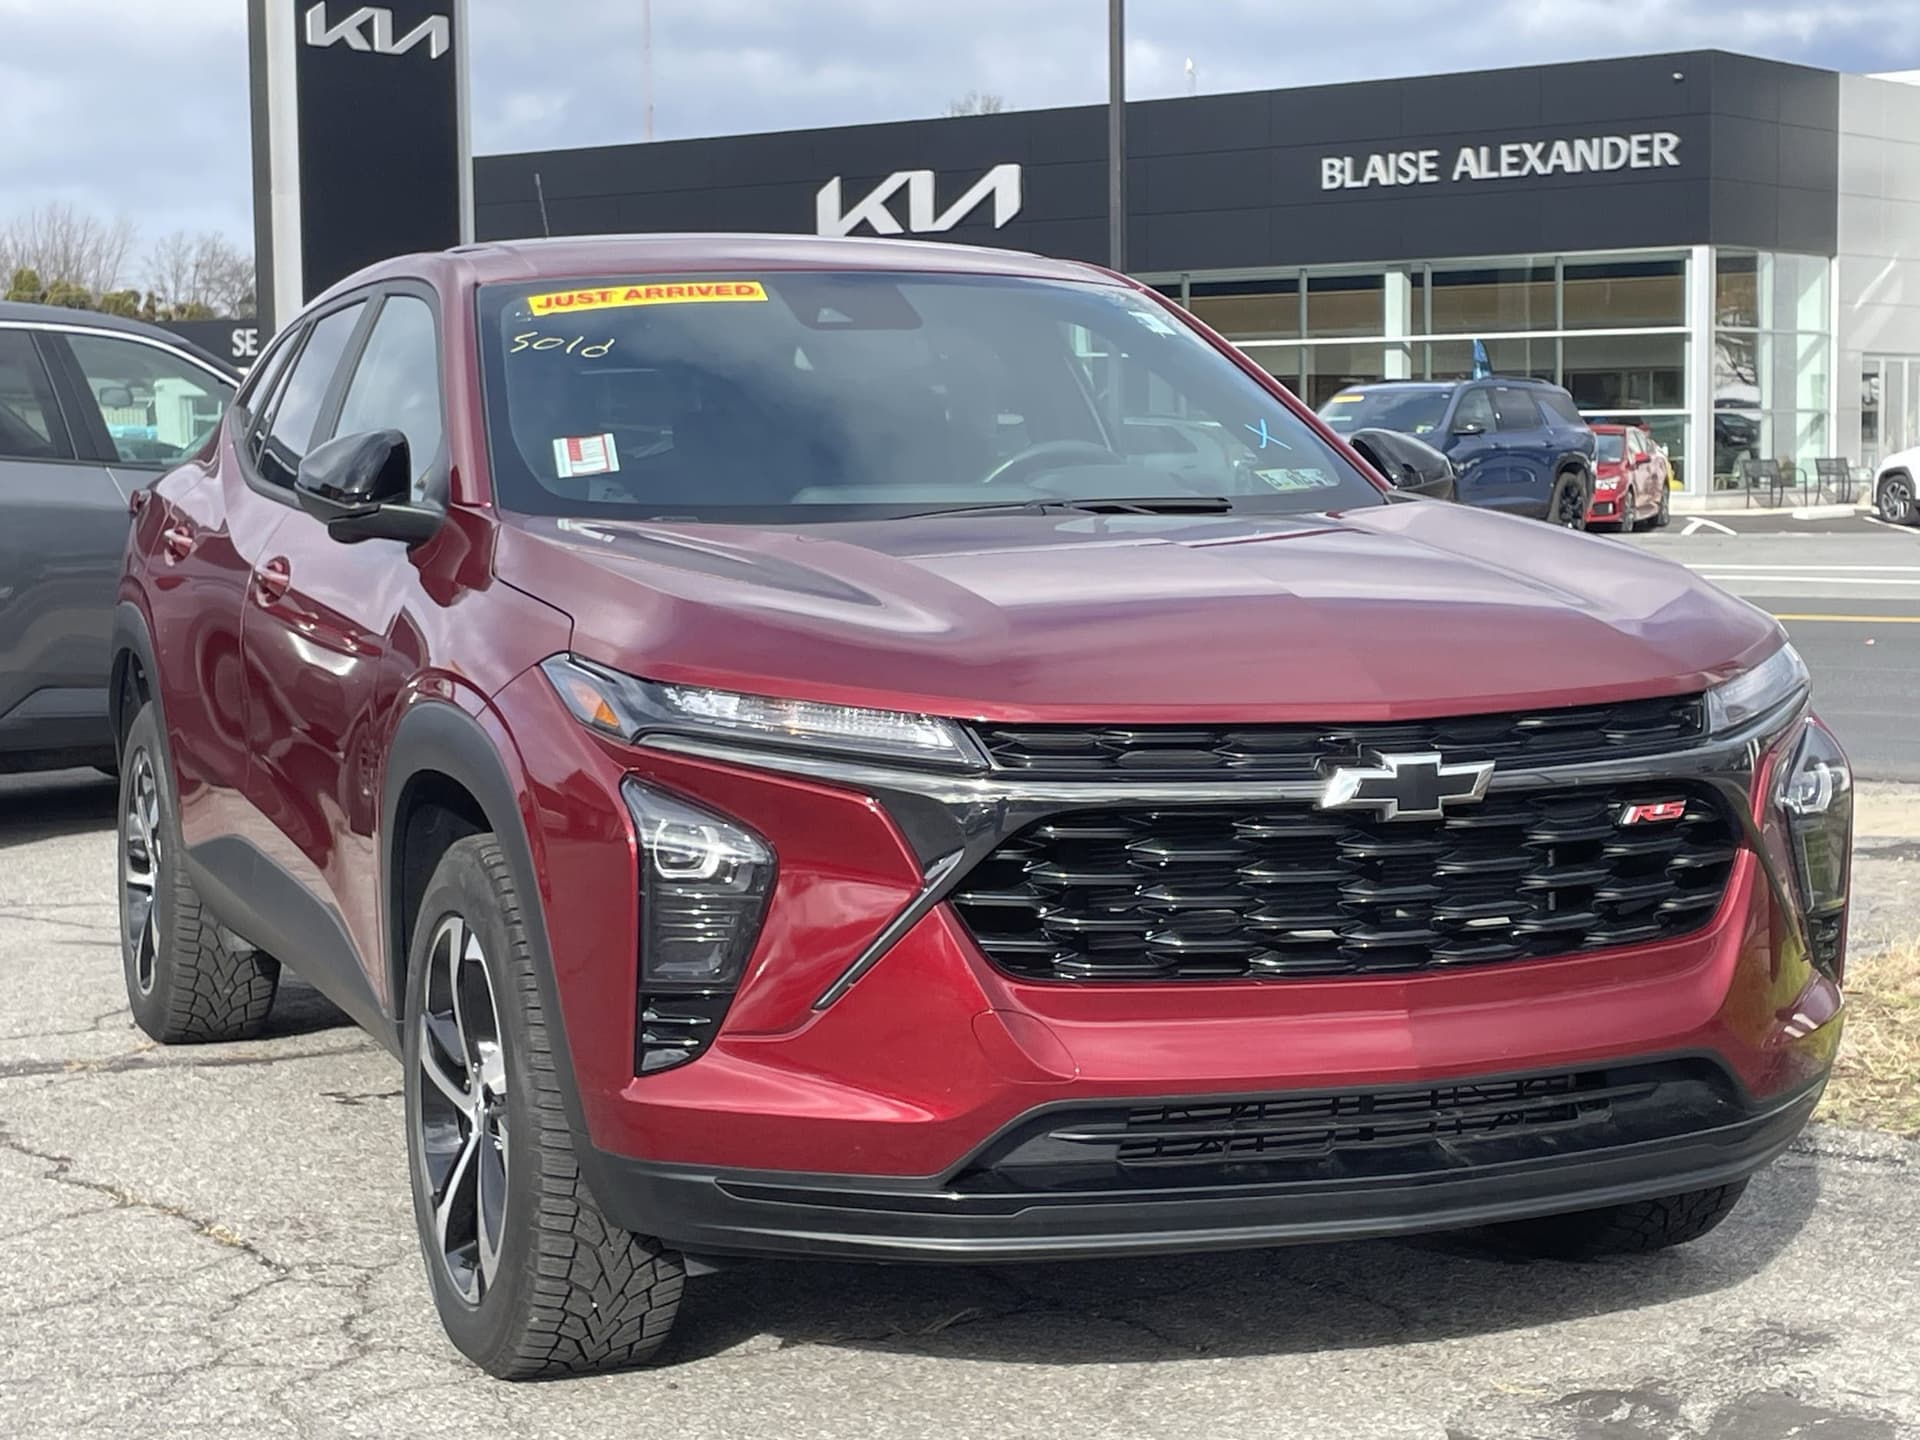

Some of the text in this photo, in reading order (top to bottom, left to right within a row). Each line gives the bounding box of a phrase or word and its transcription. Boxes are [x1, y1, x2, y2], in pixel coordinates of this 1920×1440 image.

[305, 0, 449, 59] KIA
[1321, 132, 1681, 190] BLAISE ALEXANDER
[816, 163, 1021, 236] KIA
[537, 284, 759, 309] JUST ARRIVED
[1622, 800, 1686, 825] RS
